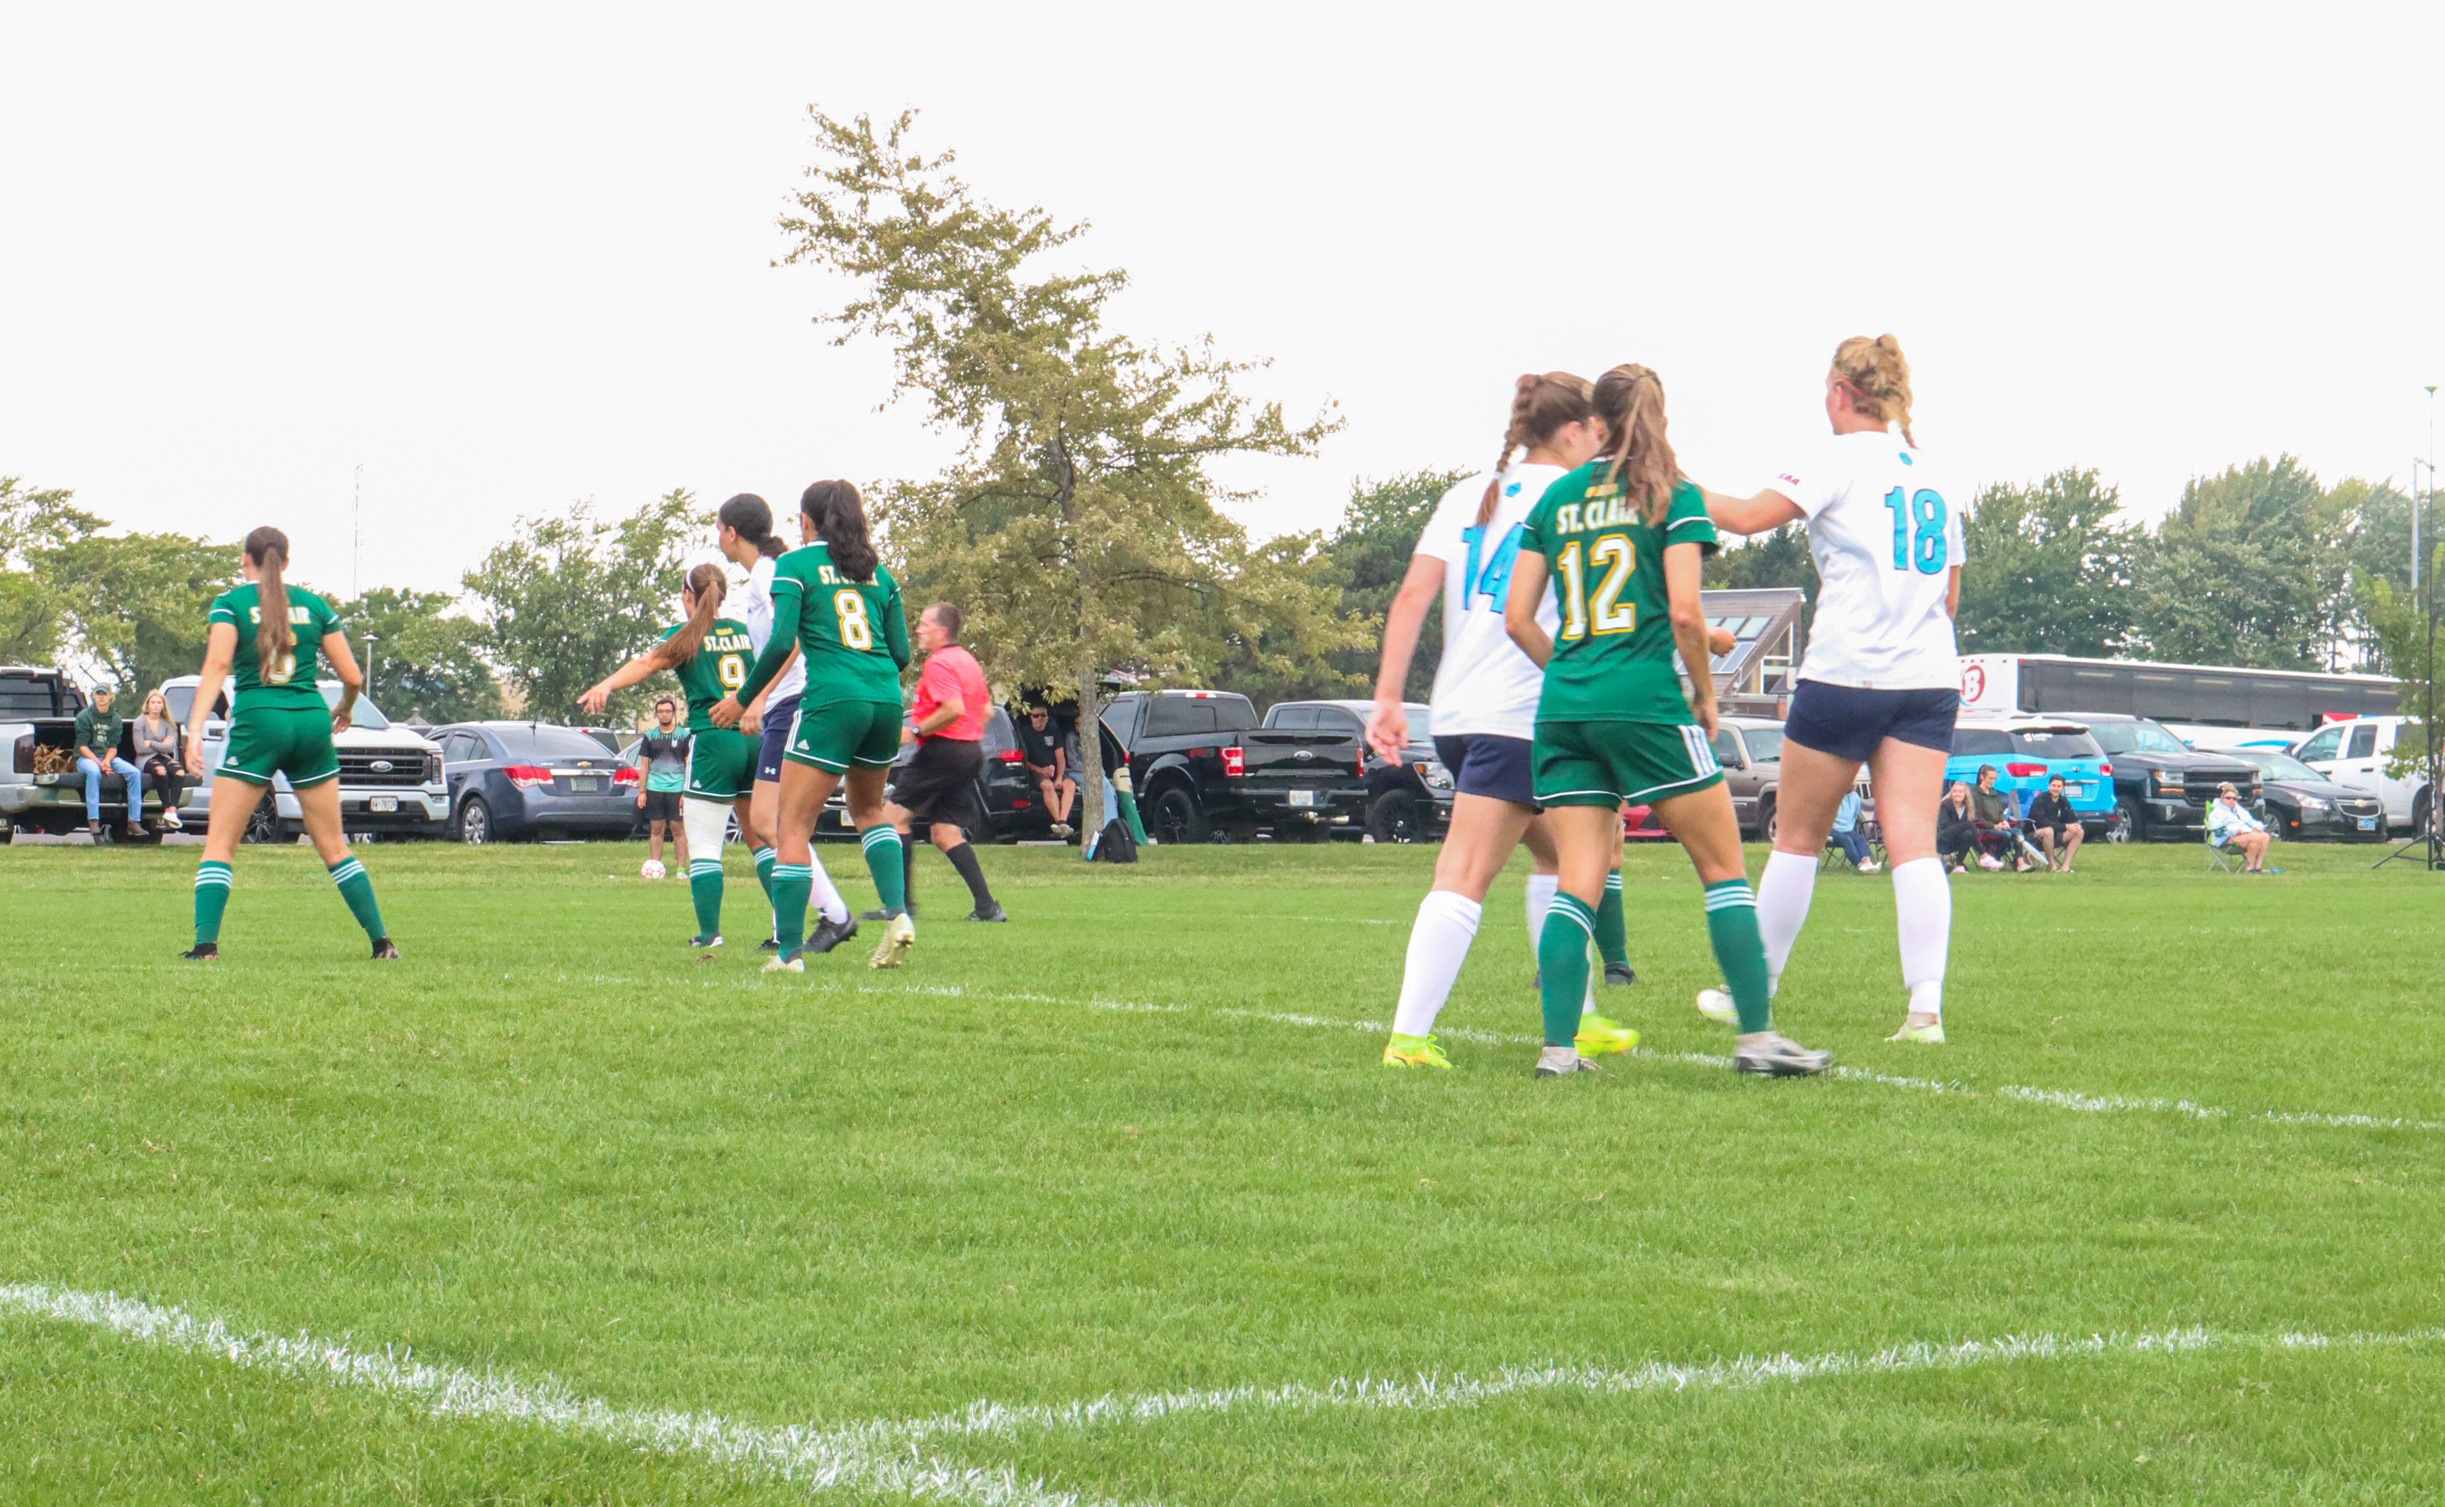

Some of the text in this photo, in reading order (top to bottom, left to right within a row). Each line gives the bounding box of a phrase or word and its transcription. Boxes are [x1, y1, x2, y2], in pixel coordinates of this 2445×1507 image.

[1462, 522, 1524, 614] 14
[1884, 485, 1947, 575] 18
[833, 588, 873, 651] 8
[1557, 533, 1636, 641] 12
[719, 653, 747, 699] 9
